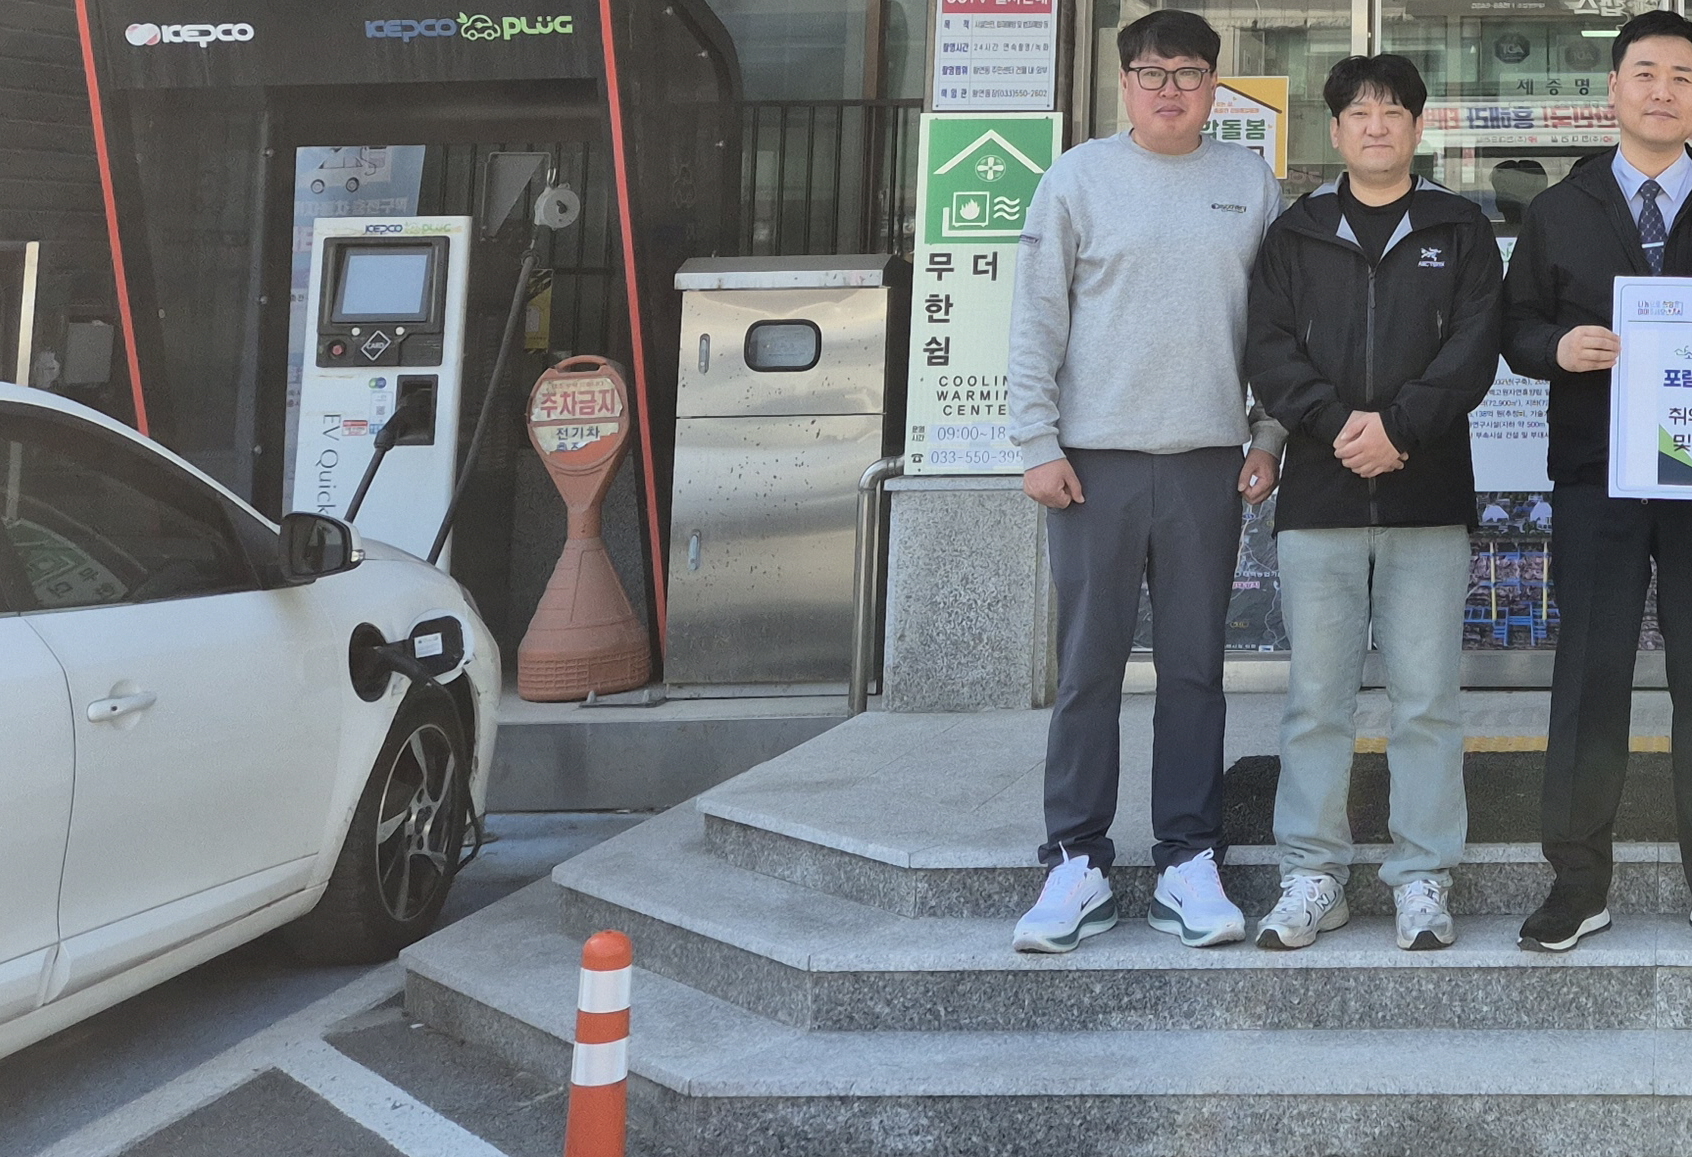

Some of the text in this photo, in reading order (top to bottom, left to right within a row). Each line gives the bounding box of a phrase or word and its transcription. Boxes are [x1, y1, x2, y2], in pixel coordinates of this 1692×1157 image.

[161, 23, 254, 48] KEPCO
[365, 18, 457, 43] KEPCO
[925, 251, 998, 281] 무더
[925, 293, 954, 323] 한
[923, 336, 950, 366] 쉼
[939, 375, 1008, 387] COOLIN
[540, 389, 615, 418] 주차금지
[937, 390, 1008, 401] WARMI
[943, 404, 1006, 416] CENTE
[556, 426, 600, 441] 전기차
[937, 426, 1006, 441] 09:00~18
[1673, 434, 1691, 452] 및
[315, 414, 342, 514] EV Quick
[930, 450, 1024, 464] 033-550-395
